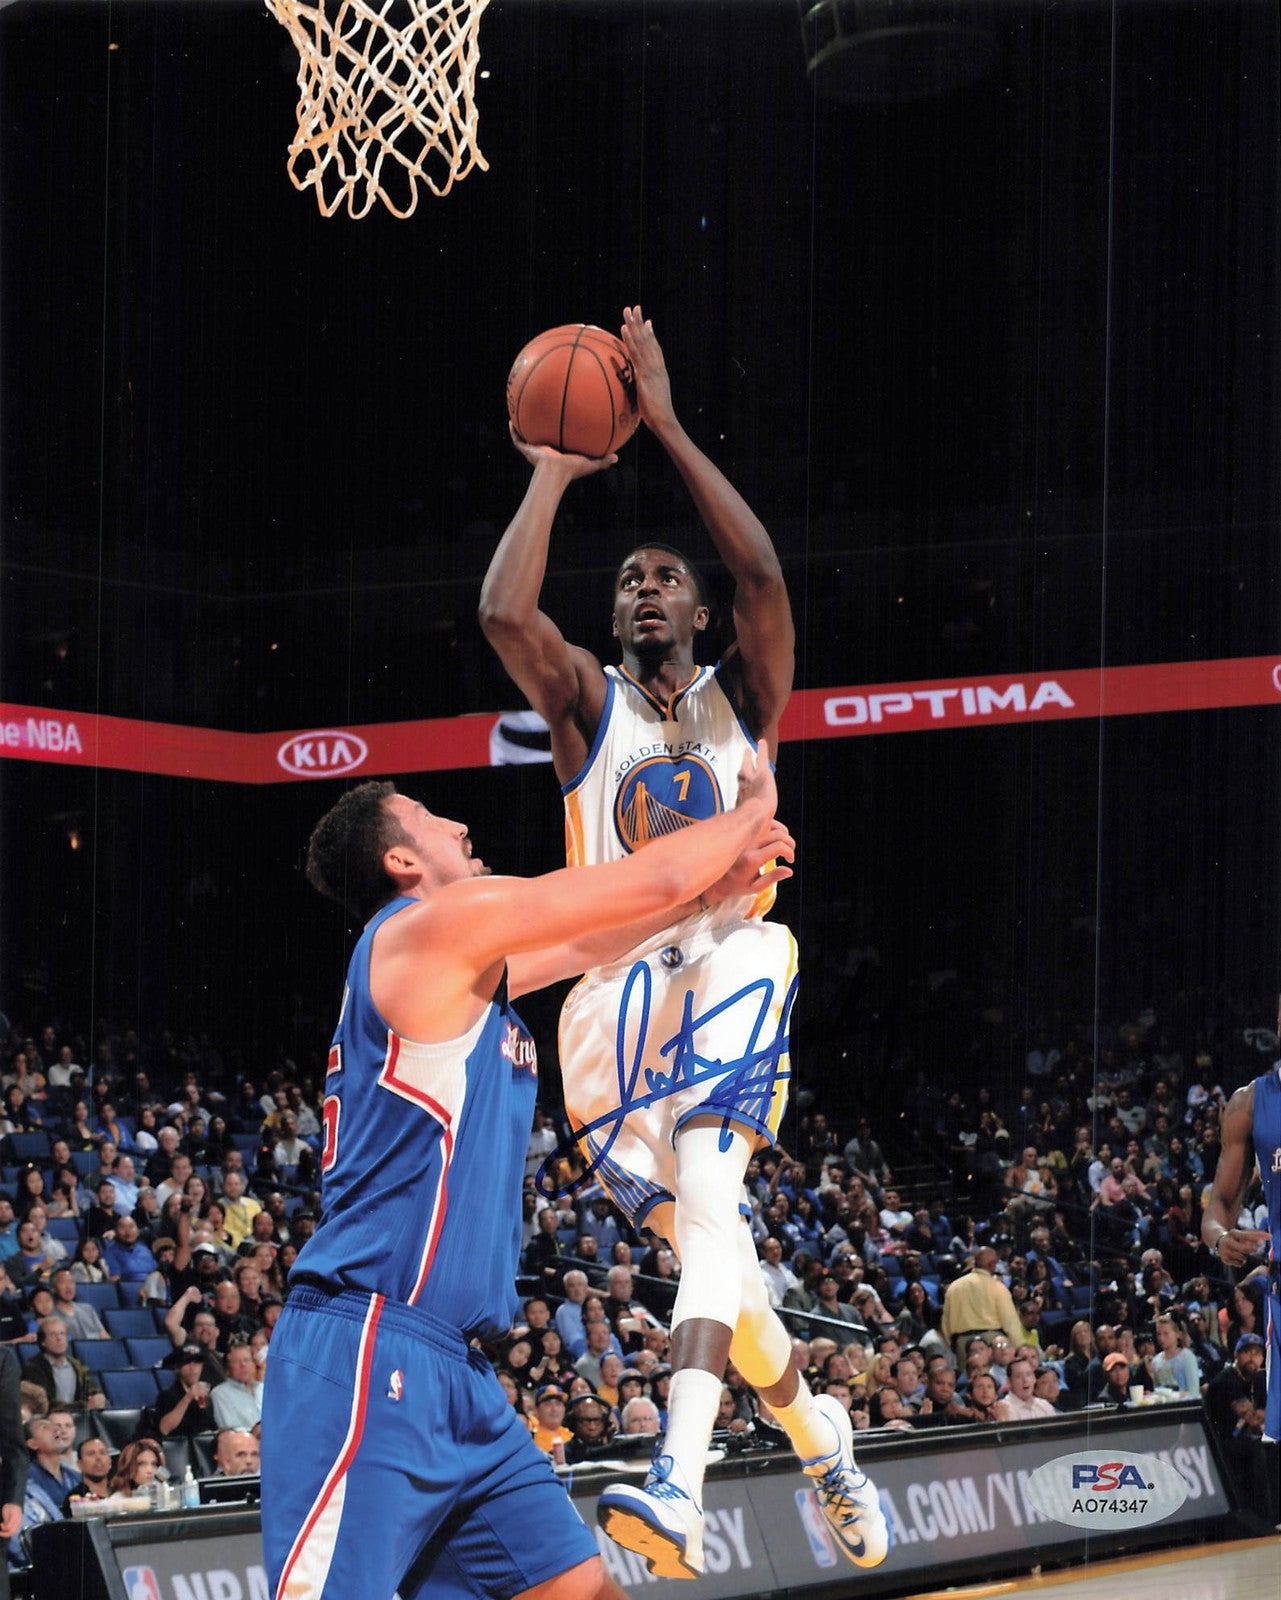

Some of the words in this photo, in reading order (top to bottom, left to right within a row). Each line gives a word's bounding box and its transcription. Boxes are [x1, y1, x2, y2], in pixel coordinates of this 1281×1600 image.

[824, 681, 1075, 726] OPTIMA
[26, 717, 82, 754] NBA
[293, 740, 353, 767] KIA
[614, 743, 674, 782] GOLDEN
[678, 741, 719, 764] STATE
[673, 769, 691, 801] 7
